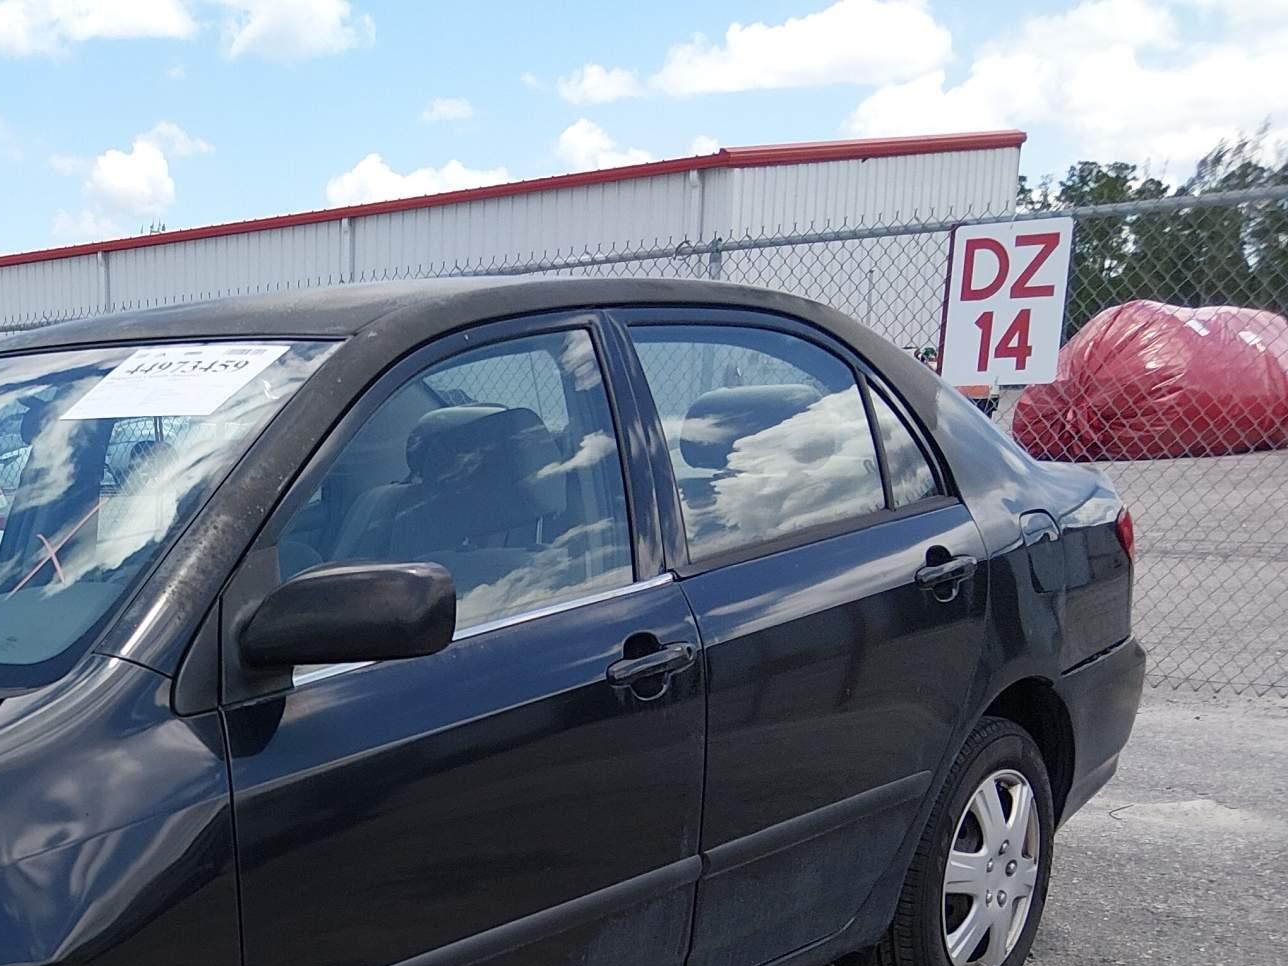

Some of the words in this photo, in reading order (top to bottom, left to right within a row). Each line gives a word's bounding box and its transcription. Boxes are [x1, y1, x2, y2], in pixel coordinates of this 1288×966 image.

[960, 232, 1060, 301] DZ
[126, 360, 250, 375] 44973459
[975, 309, 1032, 372] 14
